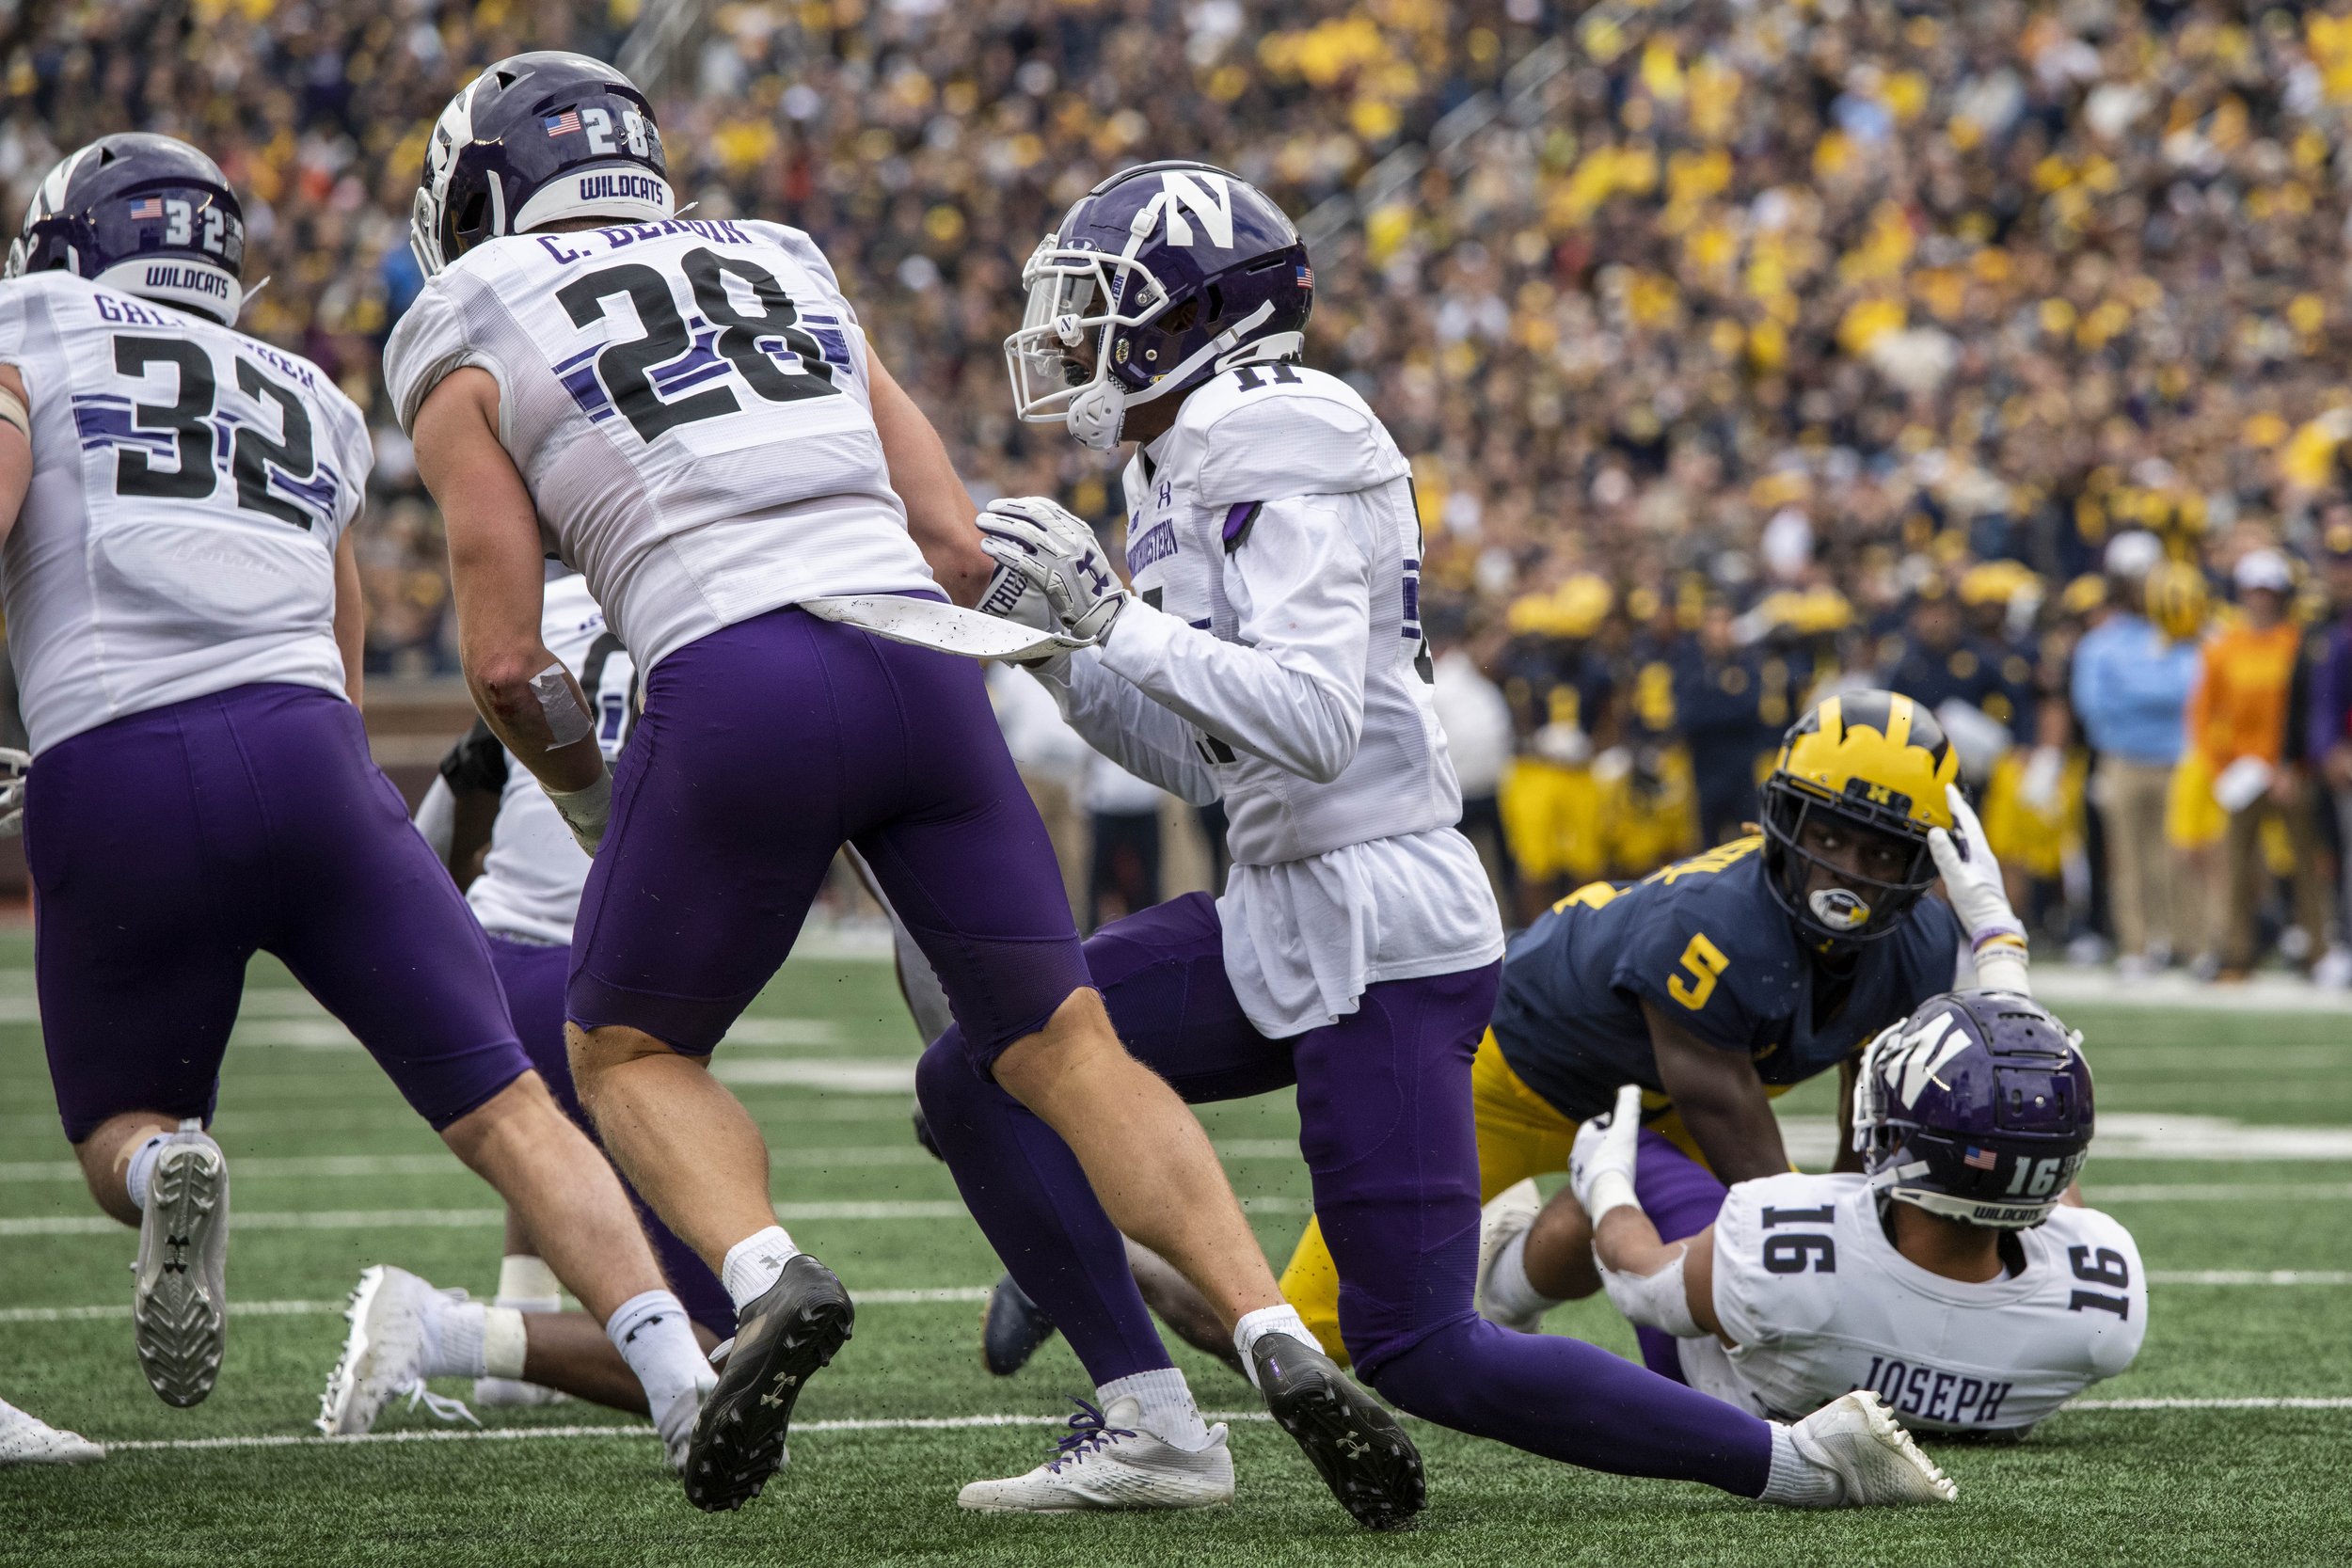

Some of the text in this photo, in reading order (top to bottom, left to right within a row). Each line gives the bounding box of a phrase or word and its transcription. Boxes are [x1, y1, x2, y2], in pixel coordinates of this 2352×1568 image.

[581, 107, 649, 158] 28
[580, 174, 663, 206] WILDCATS
[1160, 171, 1233, 249] N
[166, 198, 225, 255] 32
[537, 235, 593, 264] C.
[146, 267, 229, 300] WILDCATS
[556, 246, 842, 444] 28
[1060, 316, 1072, 333] N
[113, 334, 316, 532] 32
[1867, 784, 1891, 806] M
[1666, 932, 1730, 1010] 5
[2005, 1156, 2061, 1196] 16
[1762, 1205, 1836, 1274] 16
[1973, 1206, 2044, 1221] WILDCATS
[2068, 1244, 2129, 1322] 16
[1850, 1356, 2012, 1423] JOSEPH
